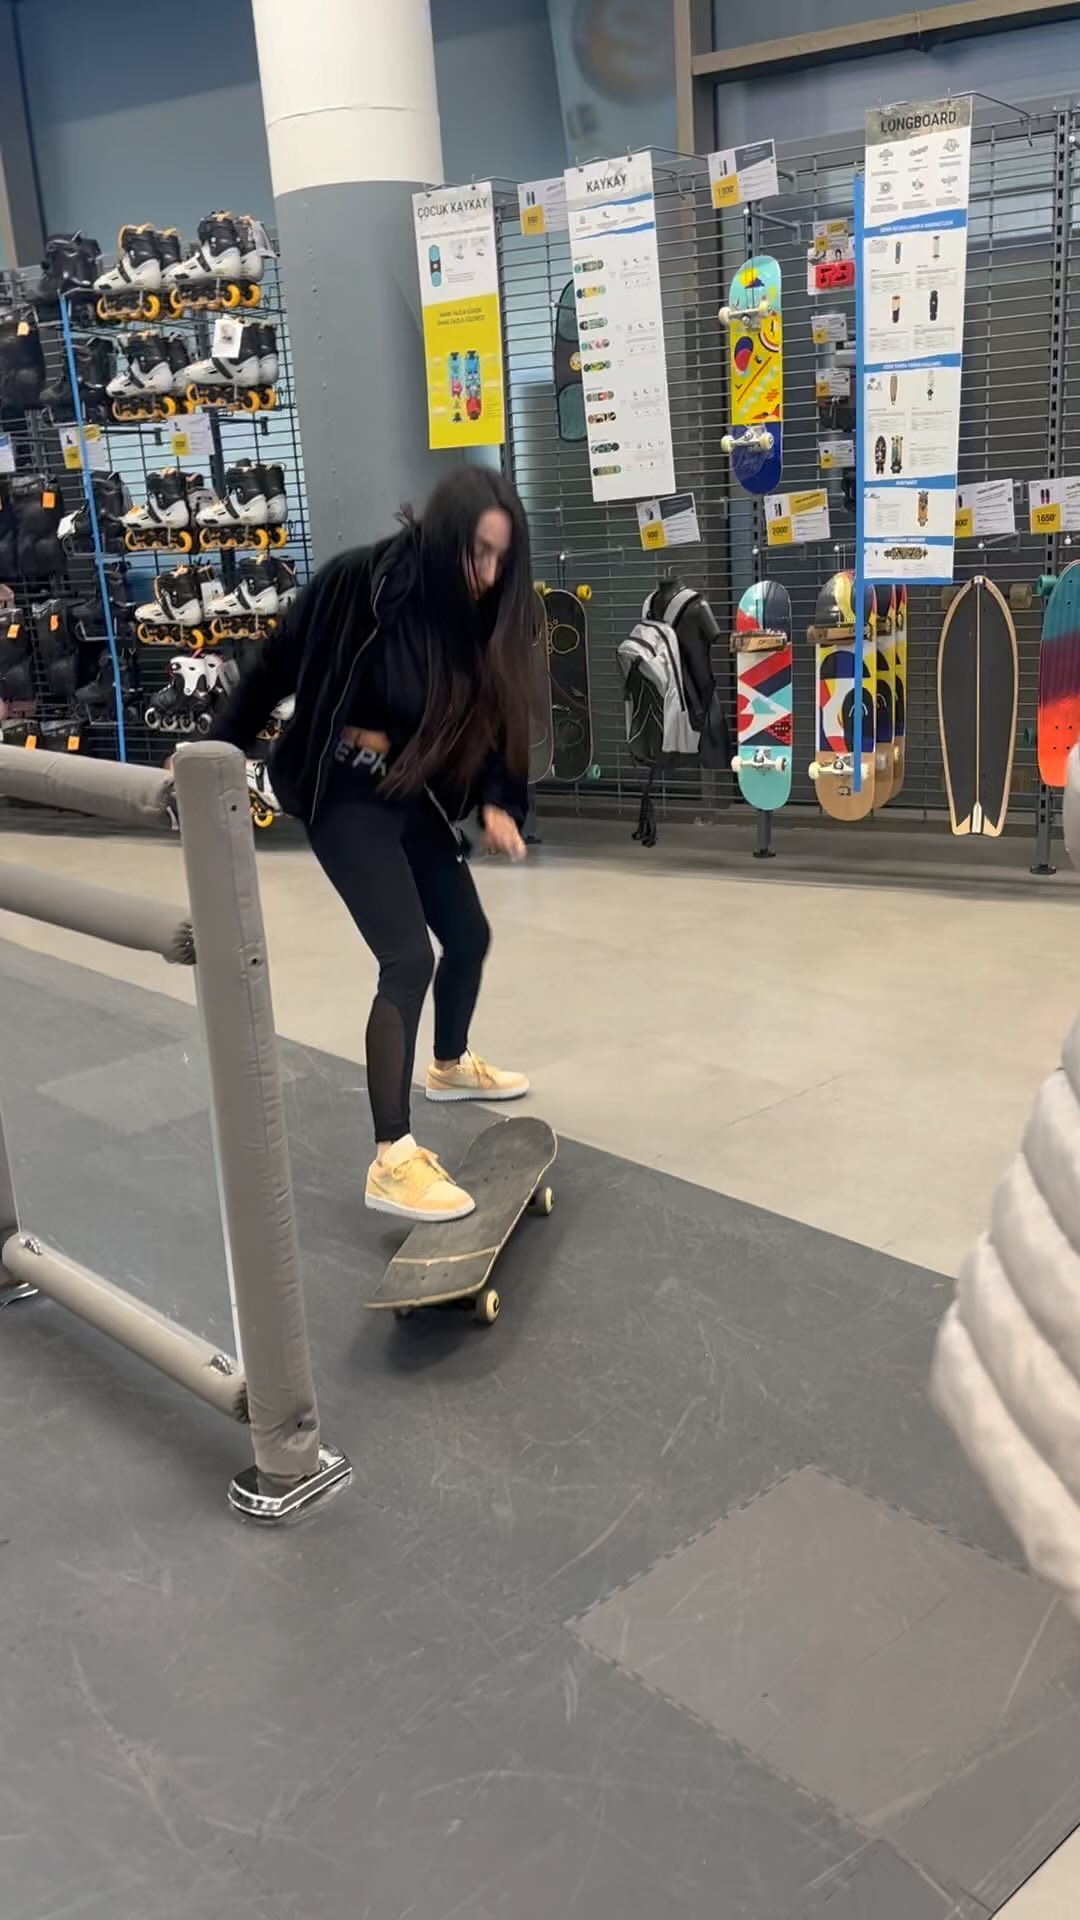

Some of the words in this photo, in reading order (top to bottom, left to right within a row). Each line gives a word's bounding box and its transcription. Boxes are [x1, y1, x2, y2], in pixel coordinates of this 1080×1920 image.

[881, 111, 957, 133] LONGBOARD
[586, 174, 627, 193] KAYKAY
[417, 205, 449, 220] ÇOCUK
[450, 197, 488, 213] KAYKAY
